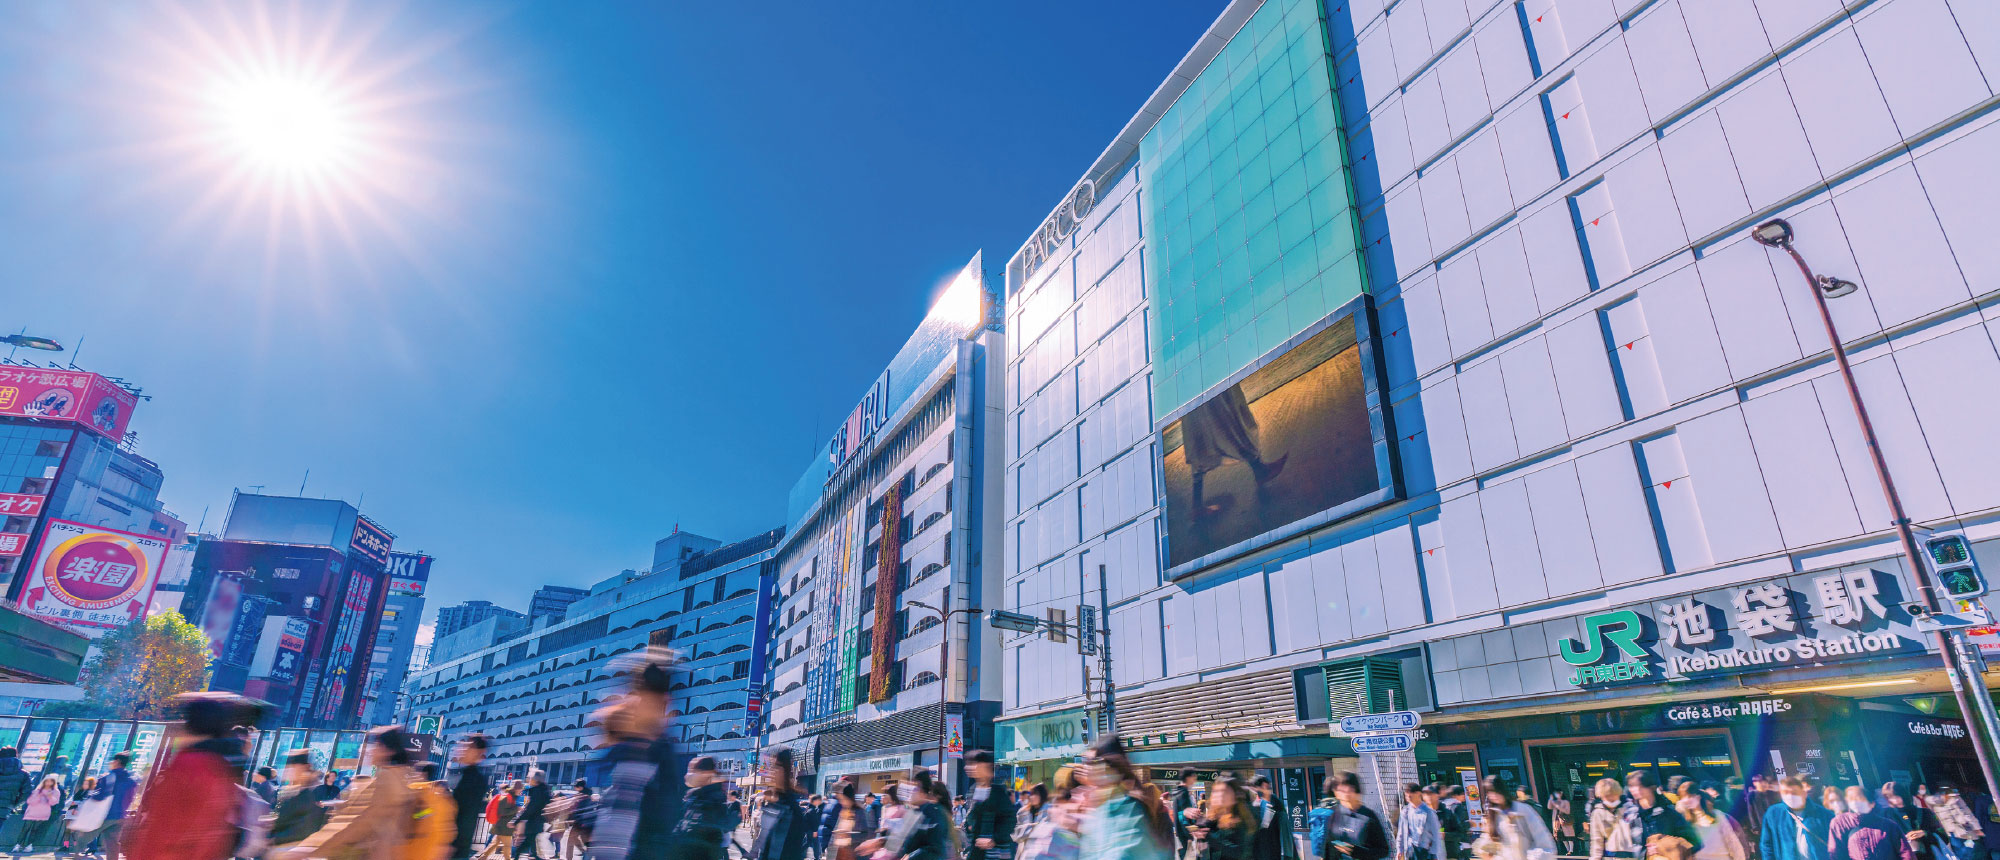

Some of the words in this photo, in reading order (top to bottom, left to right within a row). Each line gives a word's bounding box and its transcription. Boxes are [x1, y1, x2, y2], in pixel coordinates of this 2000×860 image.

[1023, 178, 1096, 283] PARCO
[828, 369, 890, 480] SEIBU
[136, 538, 165, 549] スロット
[59, 556, 137, 588] 楽園
[45, 575, 77, 606] EXCITING
[78, 588, 139, 609] AMUSEMENT
[1658, 567, 1888, 647] 池袋駅
[1558, 609, 1649, 666] JR
[1670, 646, 1791, 674] Ikebukuro
[1796, 630, 1901, 659] Station
[1568, 660, 1651, 686] JR東日本
[1668, 706, 1700, 721] Café
[1701, 708, 1712, 719] &
[1712, 705, 1739, 718] Bar
[1738, 698, 1786, 716] RAGE
[1041, 720, 1075, 743] PARCO
[1908, 721, 1926, 735] Café
